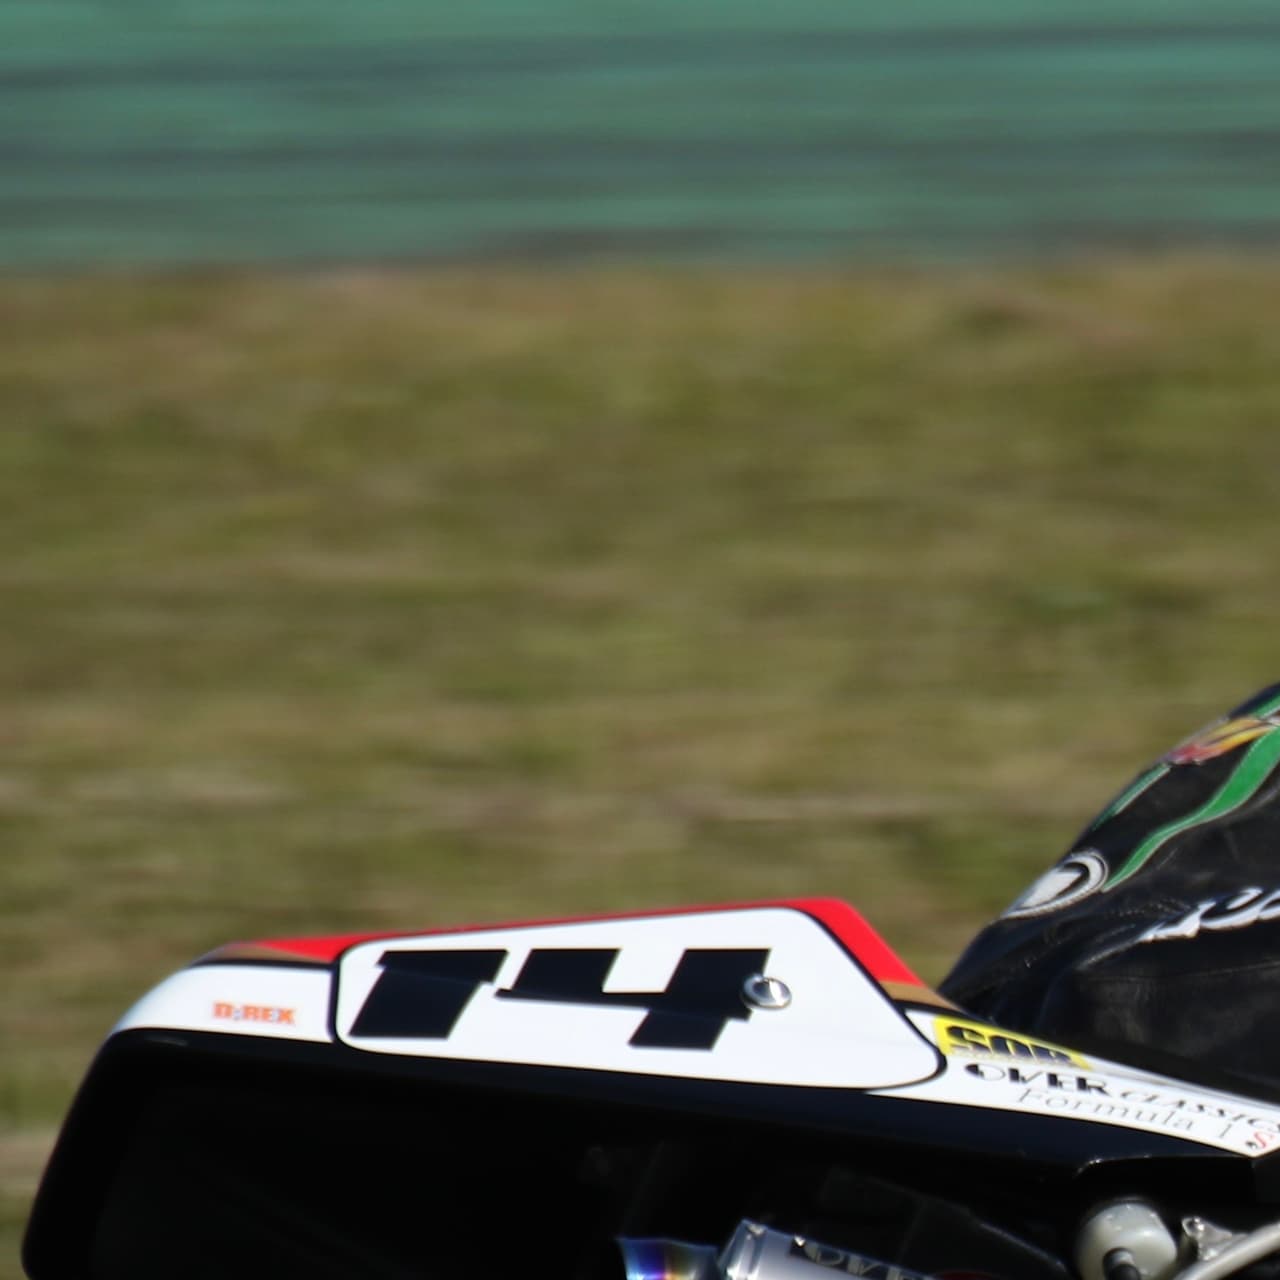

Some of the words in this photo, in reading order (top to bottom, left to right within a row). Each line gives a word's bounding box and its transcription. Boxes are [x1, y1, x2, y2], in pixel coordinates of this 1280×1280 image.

[349, 947, 773, 1052] 14
[964, 1062, 1109, 1095] OVER
[1018, 1088, 1195, 1132] Formula
